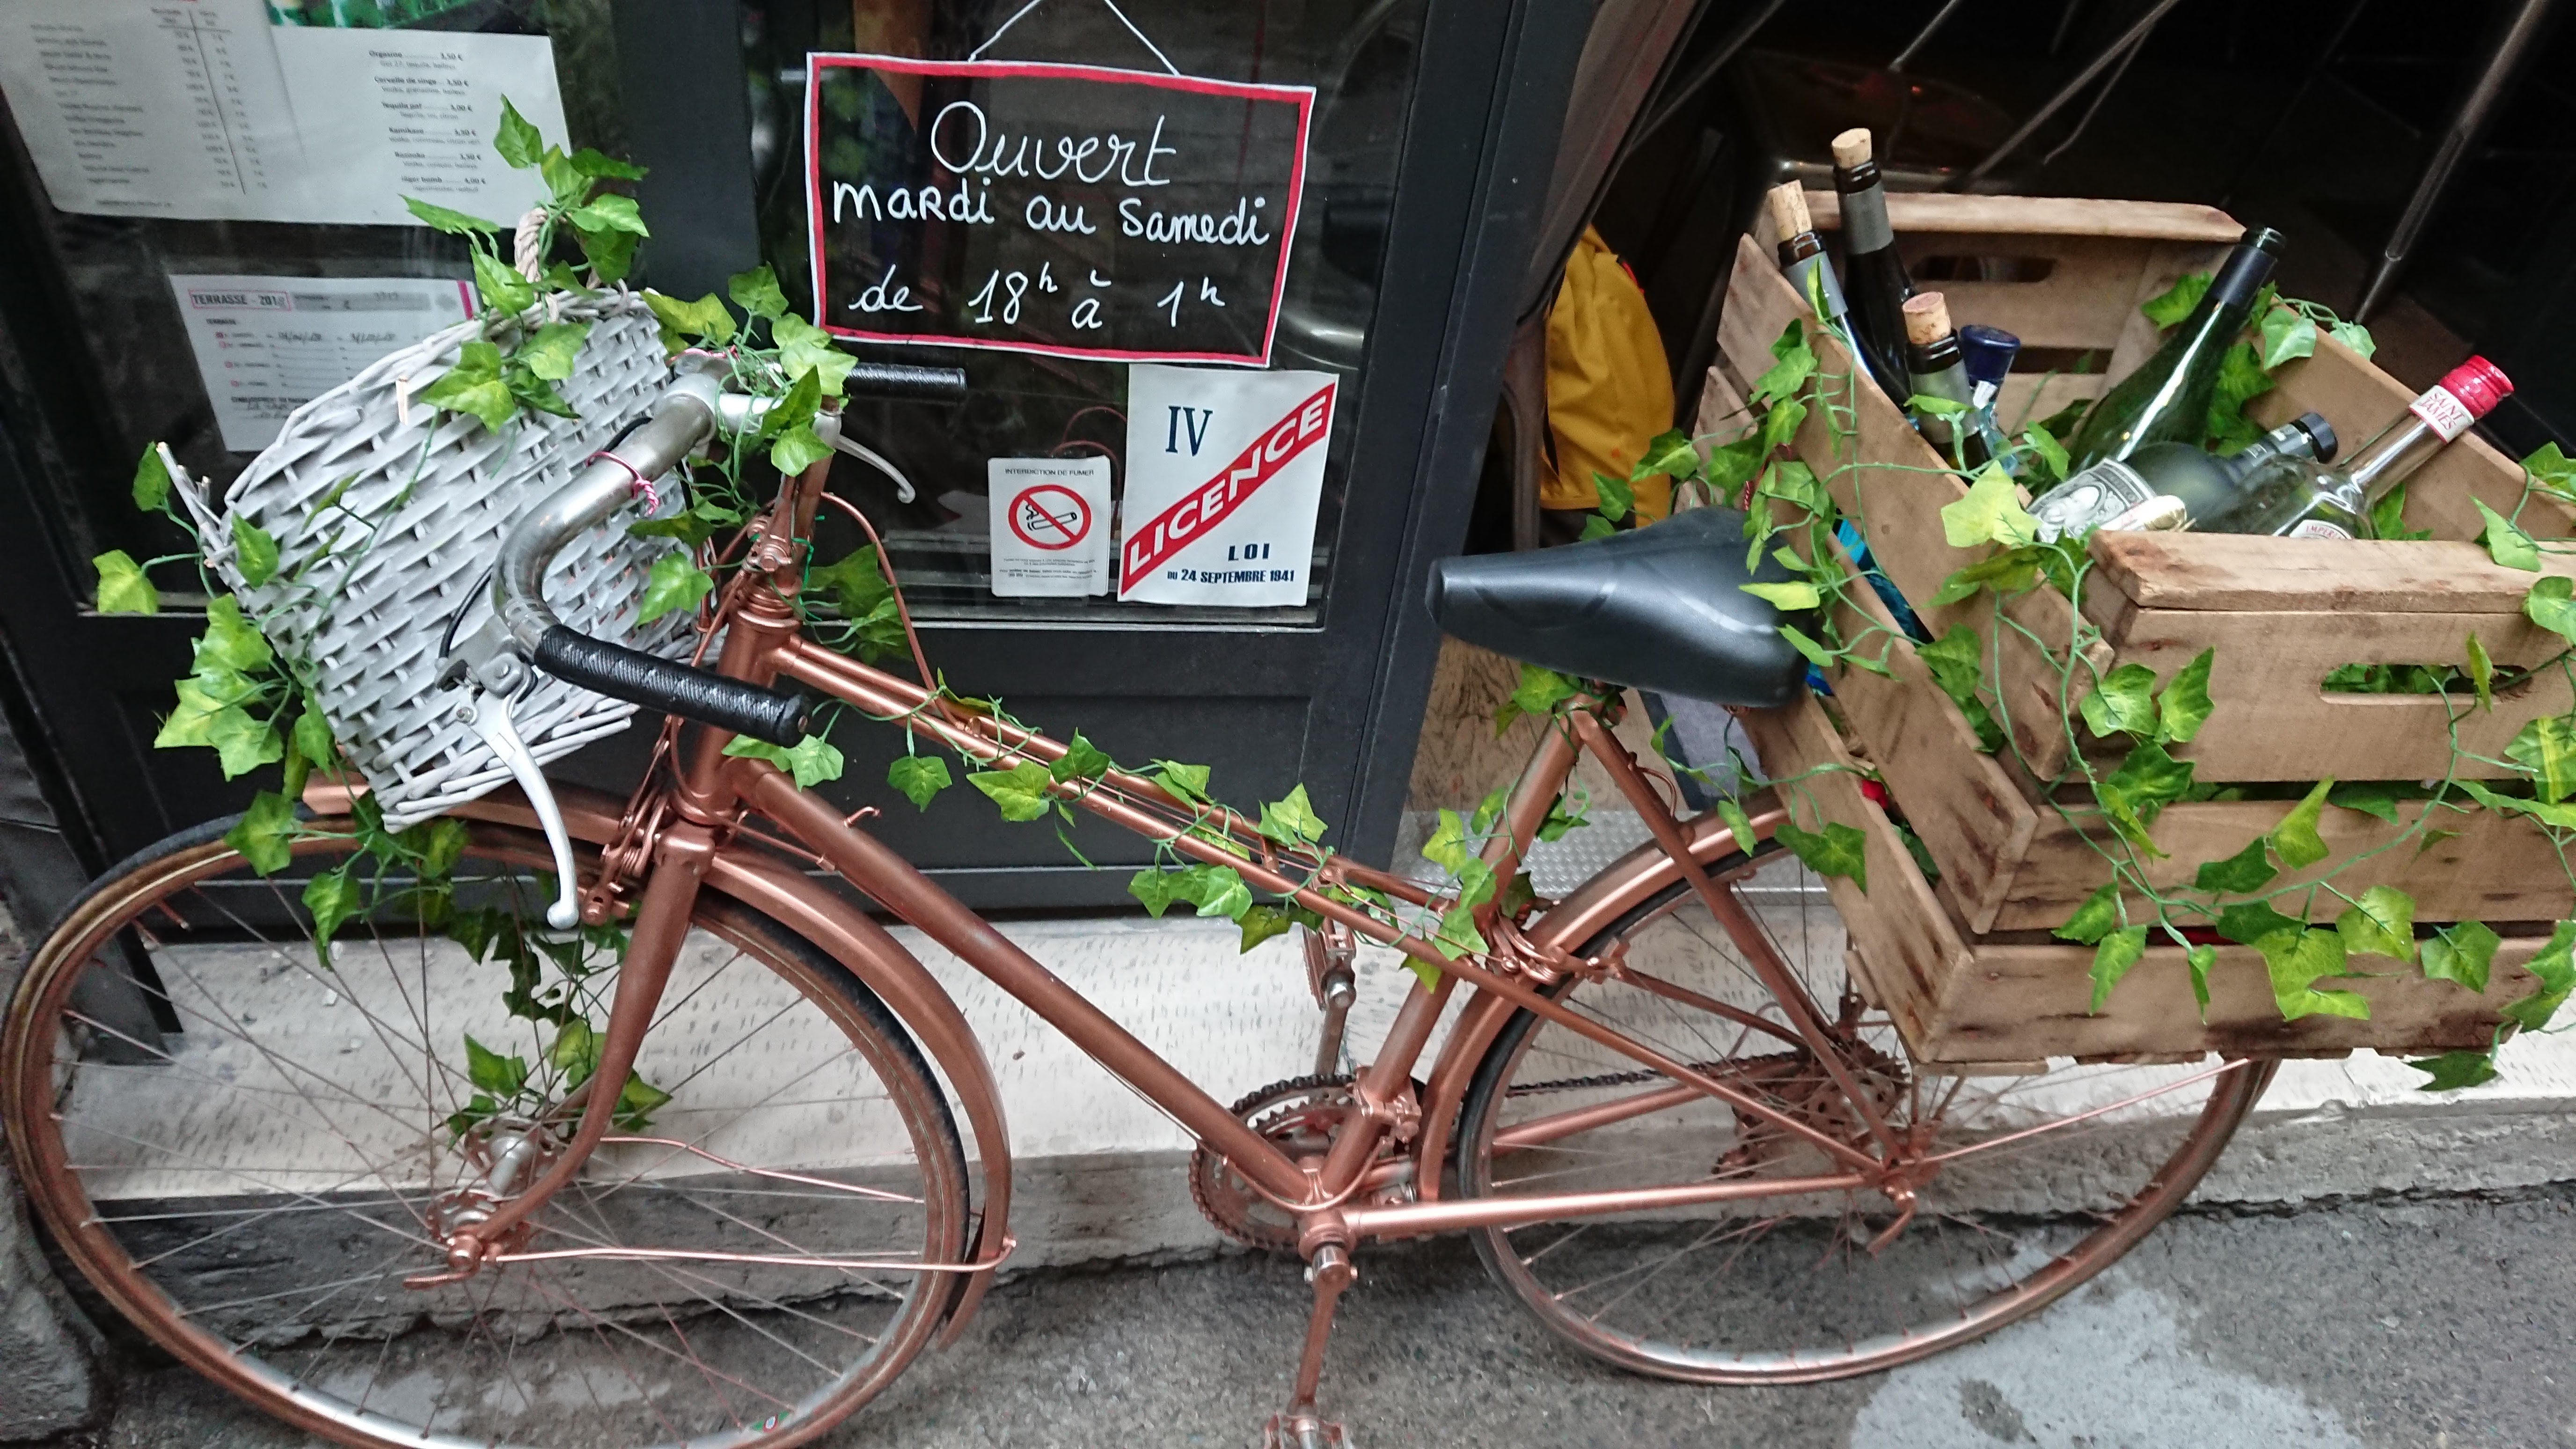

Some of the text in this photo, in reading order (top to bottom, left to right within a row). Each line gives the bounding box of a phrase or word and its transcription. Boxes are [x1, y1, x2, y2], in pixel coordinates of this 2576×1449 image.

[930, 100, 1177, 186] Ouvert
[1026, 195, 1096, 235] au
[192, 294, 248, 305] TERRASSE
[849, 264, 923, 312] de
[2417, 396, 2457, 430] JAMES
[2432, 392, 2465, 420] SAINT
[1165, 405, 1213, 457] IV
[1129, 394, 1326, 576] LICENCE
[1228, 542, 1270, 561] LOI
[1167, 569, 1295, 584] DU 24 SEPTEMBRE 1941
